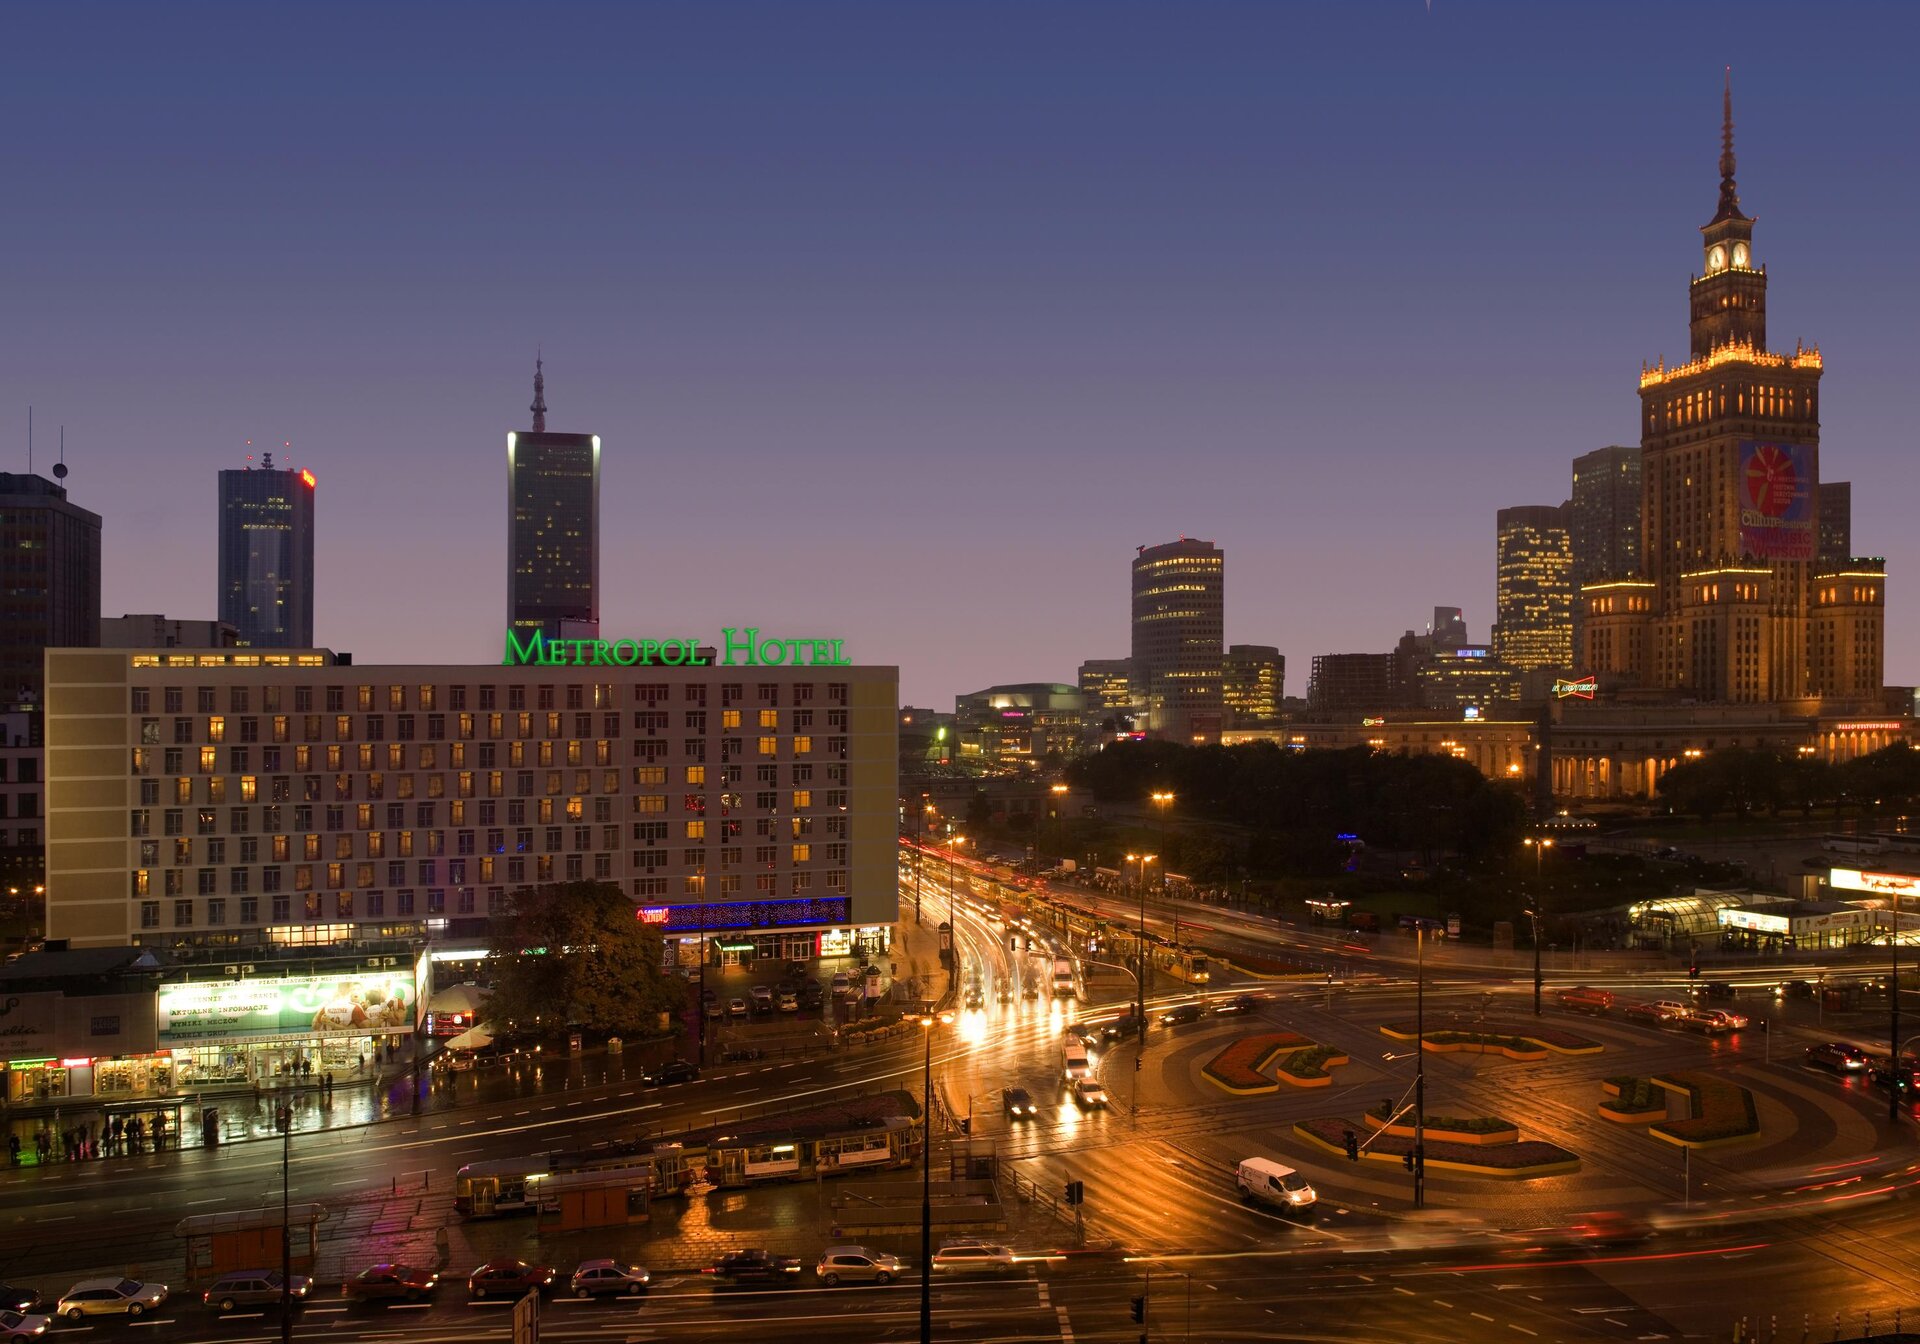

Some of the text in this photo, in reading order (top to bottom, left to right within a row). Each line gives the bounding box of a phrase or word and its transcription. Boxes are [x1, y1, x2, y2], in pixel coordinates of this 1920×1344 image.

[1742, 512, 1782, 528] Culture
[171, 1004, 268, 1016] AKTUALNE INFORMACJE
[207, 1017, 238, 1025] MECZÓW
[318, 1030, 362, 1038] ZAPRASZA
